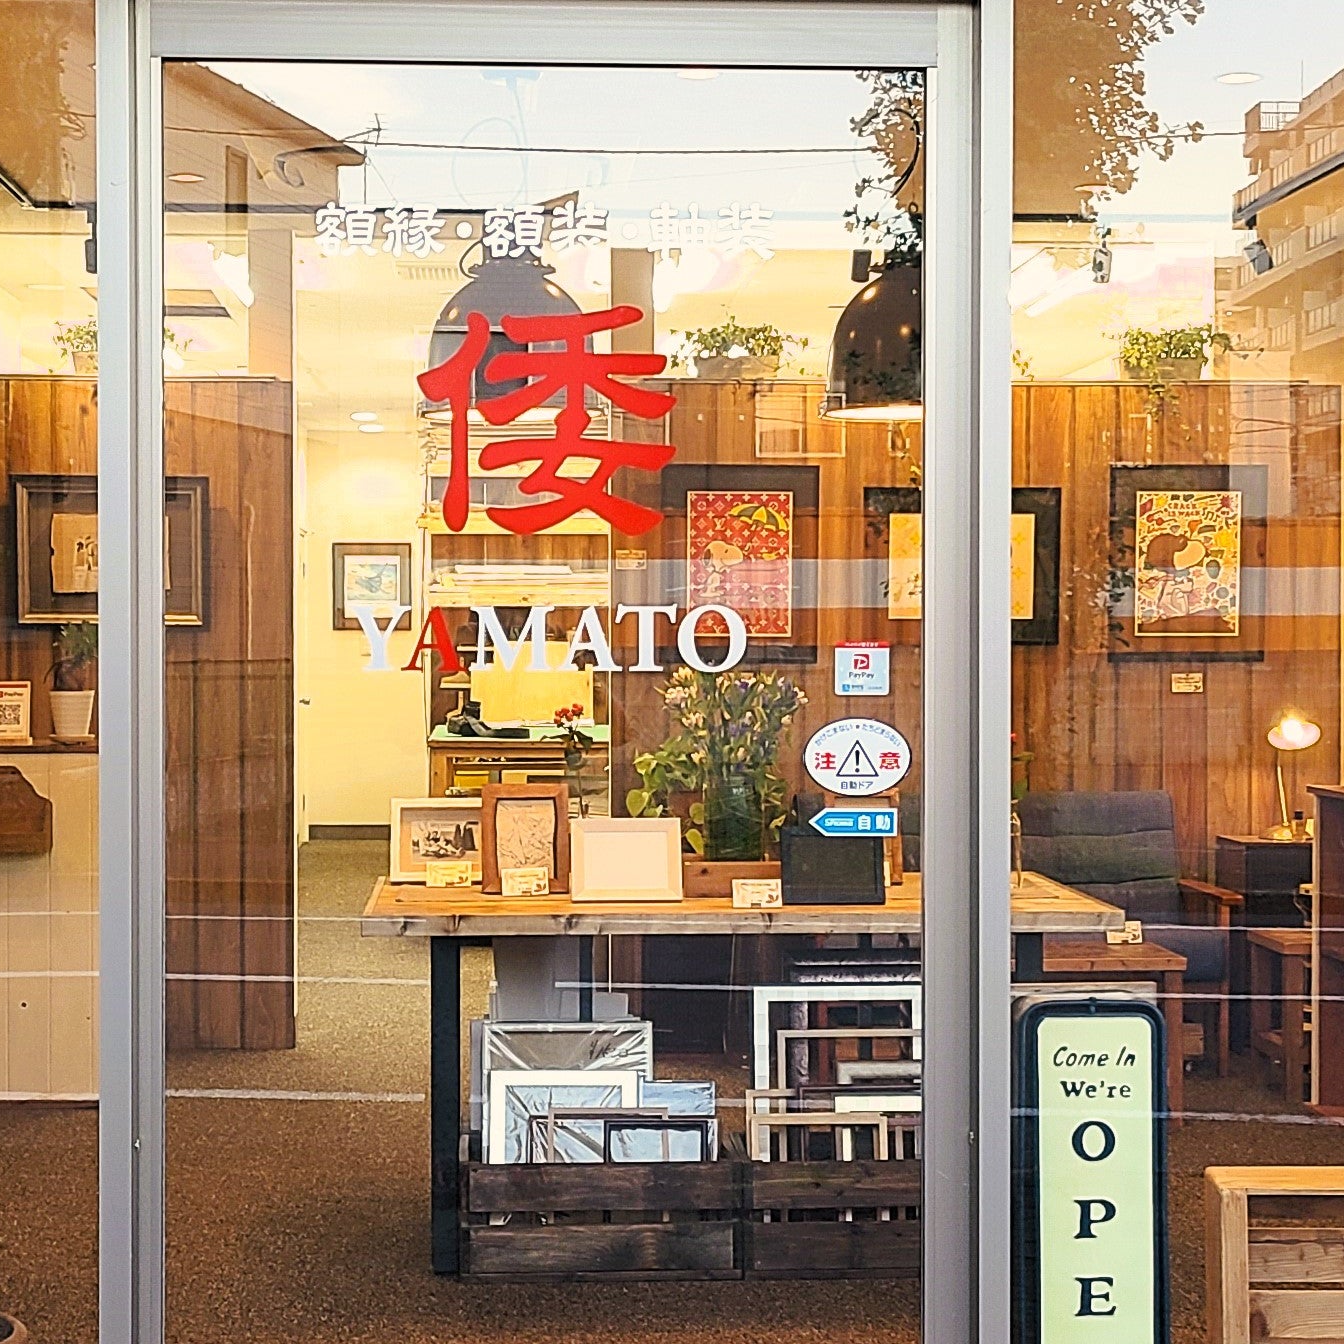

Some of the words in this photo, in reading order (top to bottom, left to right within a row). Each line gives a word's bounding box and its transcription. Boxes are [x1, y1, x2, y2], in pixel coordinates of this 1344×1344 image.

[417, 305, 677, 536] 倭
[356, 603, 748, 673] YAMATO
[849, 671, 874, 680] PayPay
[840, 781, 874, 790] 自動ドア
[857, 814, 891, 831] 自動
[1053, 1046, 1109, 1068] Come
[1115, 1046, 1136, 1068] In
[1060, 1080, 1131, 1099] We're
